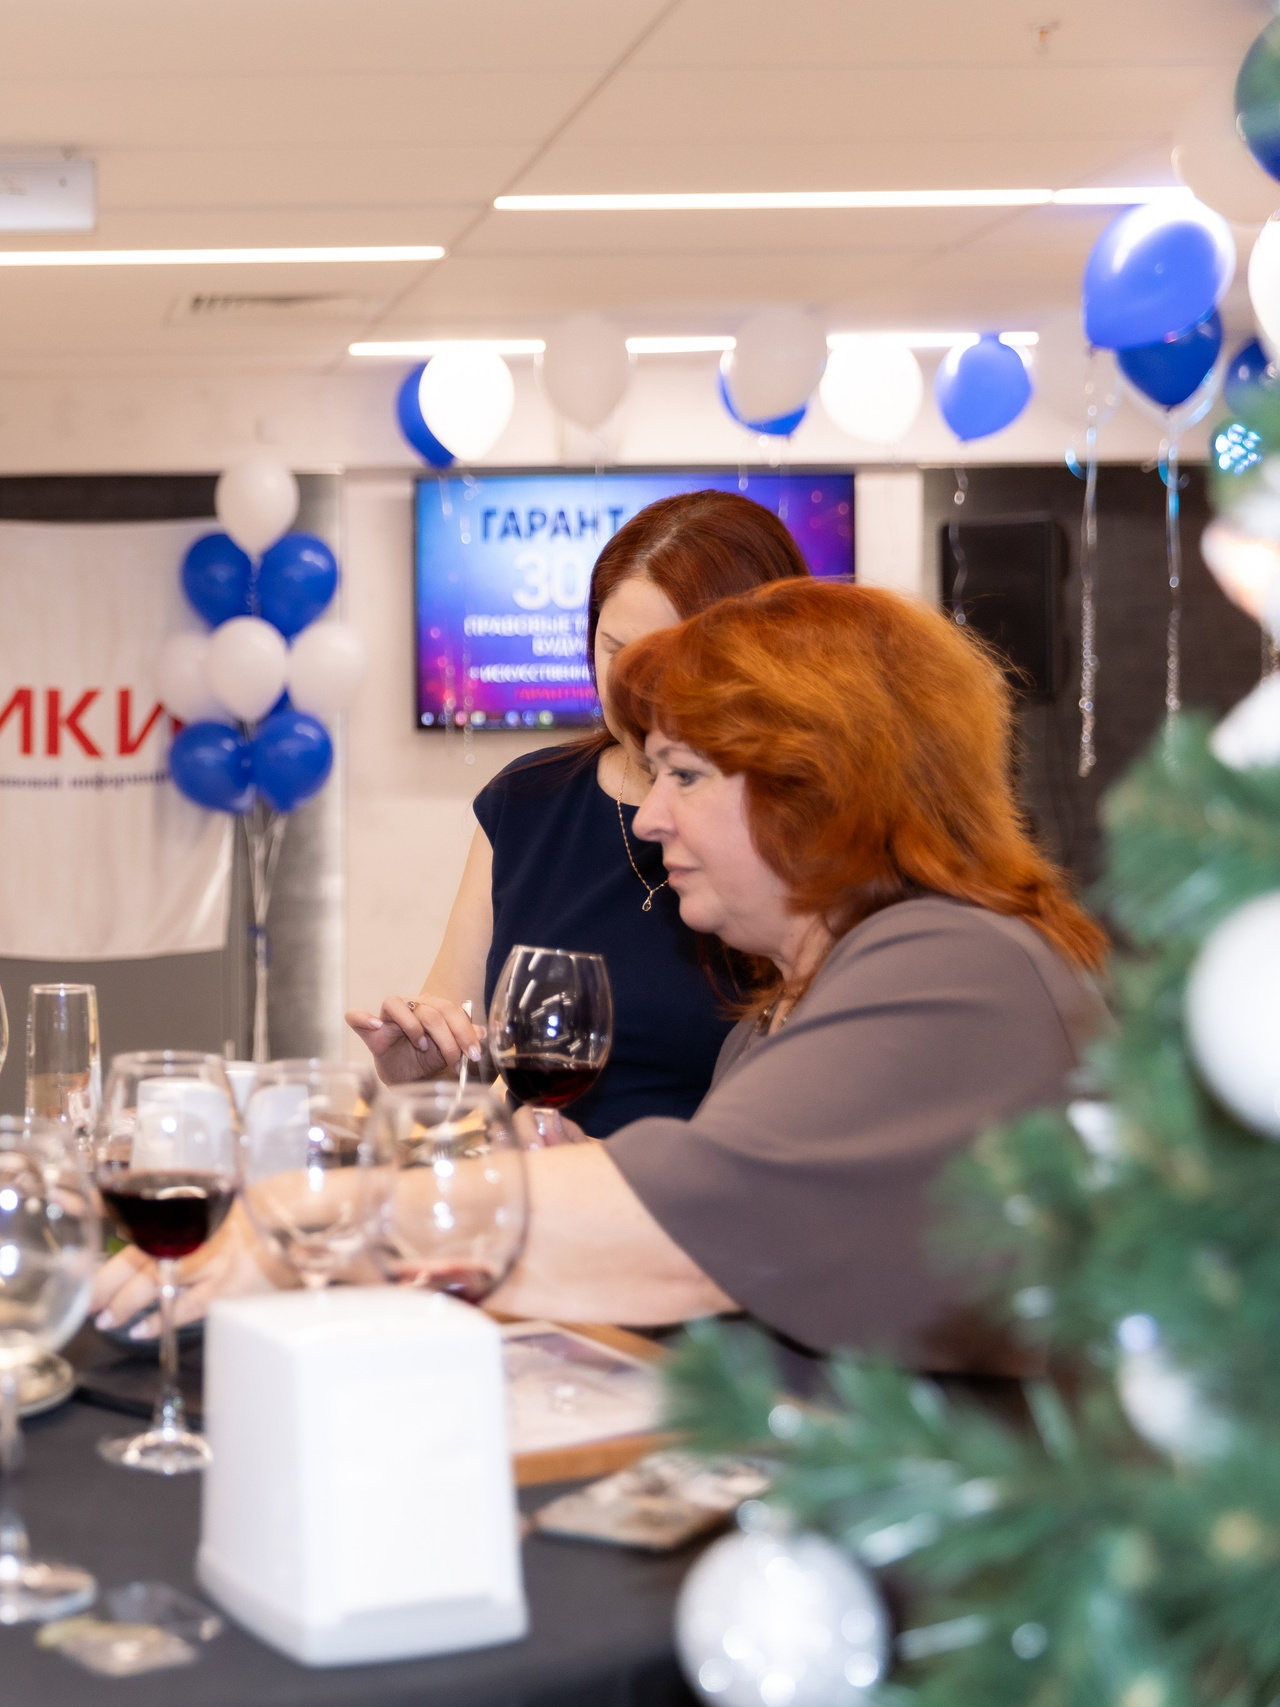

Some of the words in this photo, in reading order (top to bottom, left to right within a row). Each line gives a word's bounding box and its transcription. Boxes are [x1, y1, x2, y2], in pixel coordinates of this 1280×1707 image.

[480, 507, 625, 541] ГАРАНТ
[464, 614, 571, 637] ПРАВОВЫЕ
[532, 635, 586, 658] БУДУ
